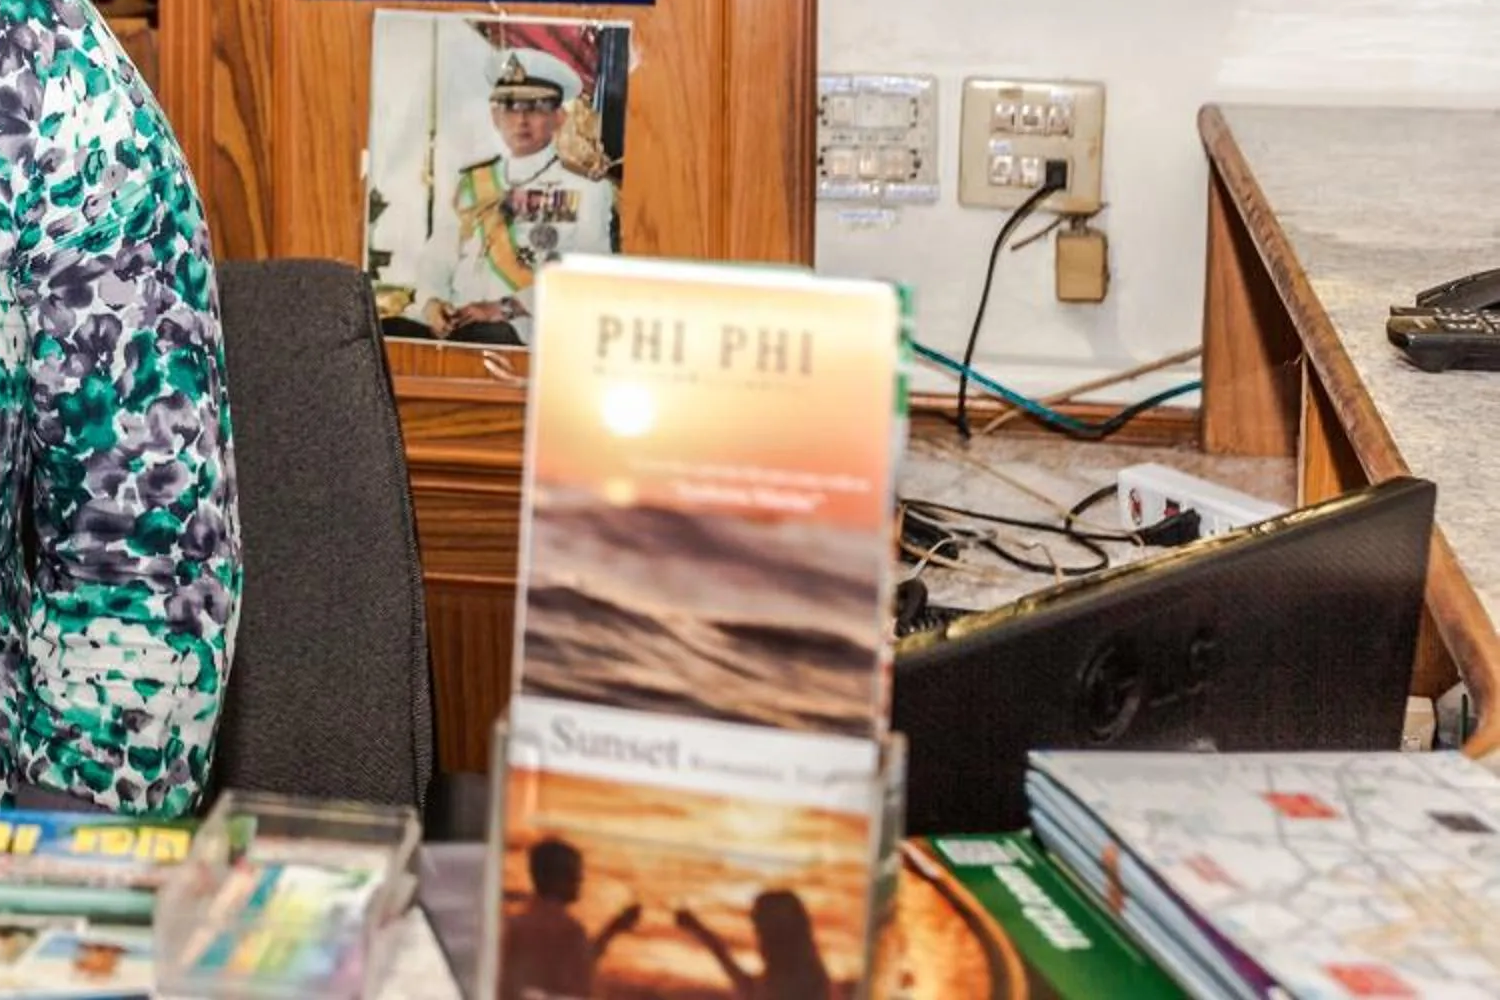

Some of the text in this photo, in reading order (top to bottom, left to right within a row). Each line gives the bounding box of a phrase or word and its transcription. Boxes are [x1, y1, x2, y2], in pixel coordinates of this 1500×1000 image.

[596, 315, 814, 376] PHI PHI
[550, 714, 680, 769] Sunset
